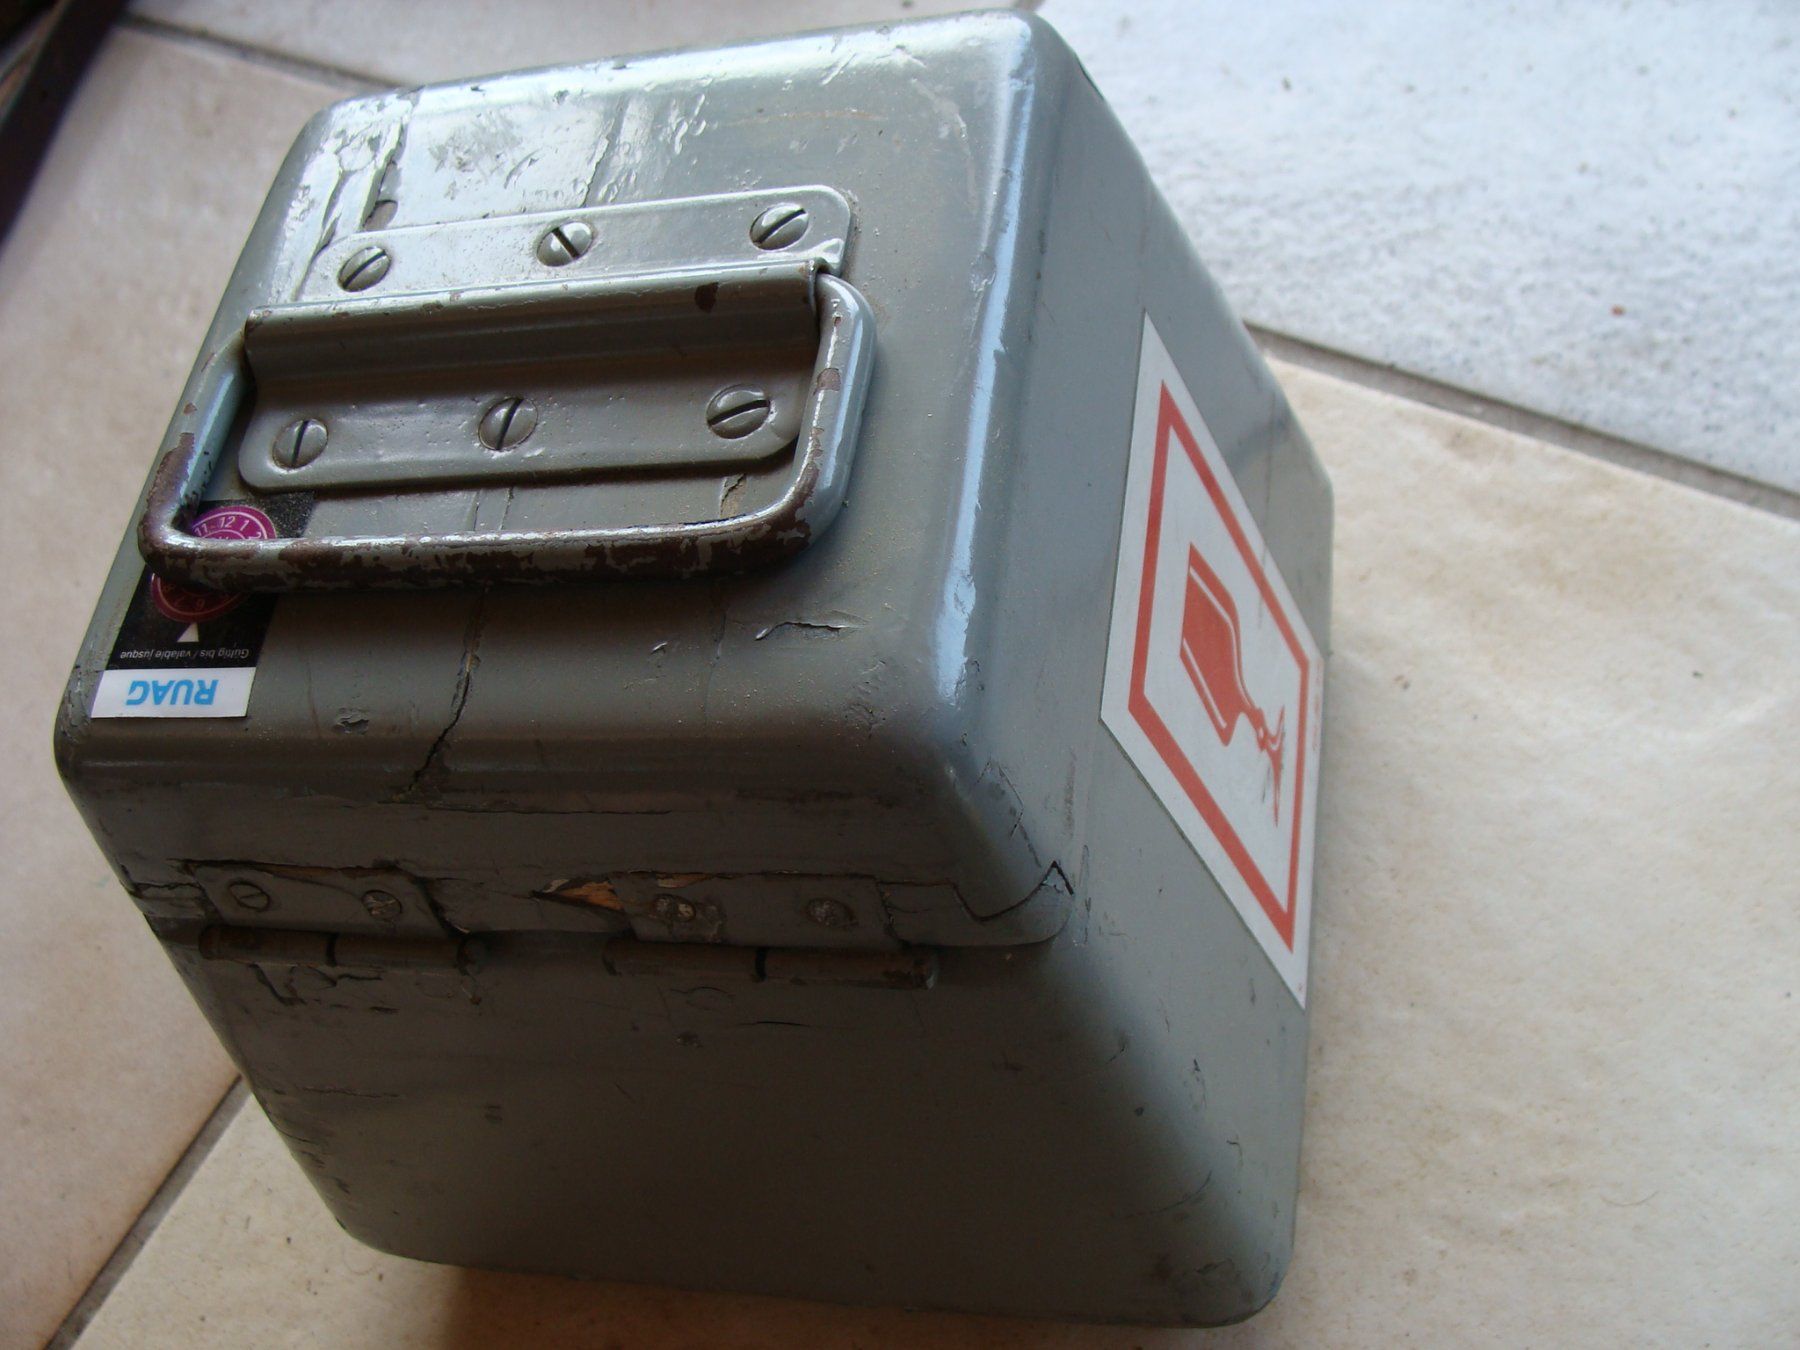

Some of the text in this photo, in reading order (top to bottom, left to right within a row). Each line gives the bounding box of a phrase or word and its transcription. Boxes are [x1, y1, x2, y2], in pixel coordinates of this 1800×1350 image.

[219, 516, 235, 529] 12
[240, 519, 250, 531] 1
[120, 650, 154, 661] jusque
[155, 649, 191, 660] valable
[200, 649, 215, 659] bis
[125, 679, 219, 706] RUAG
